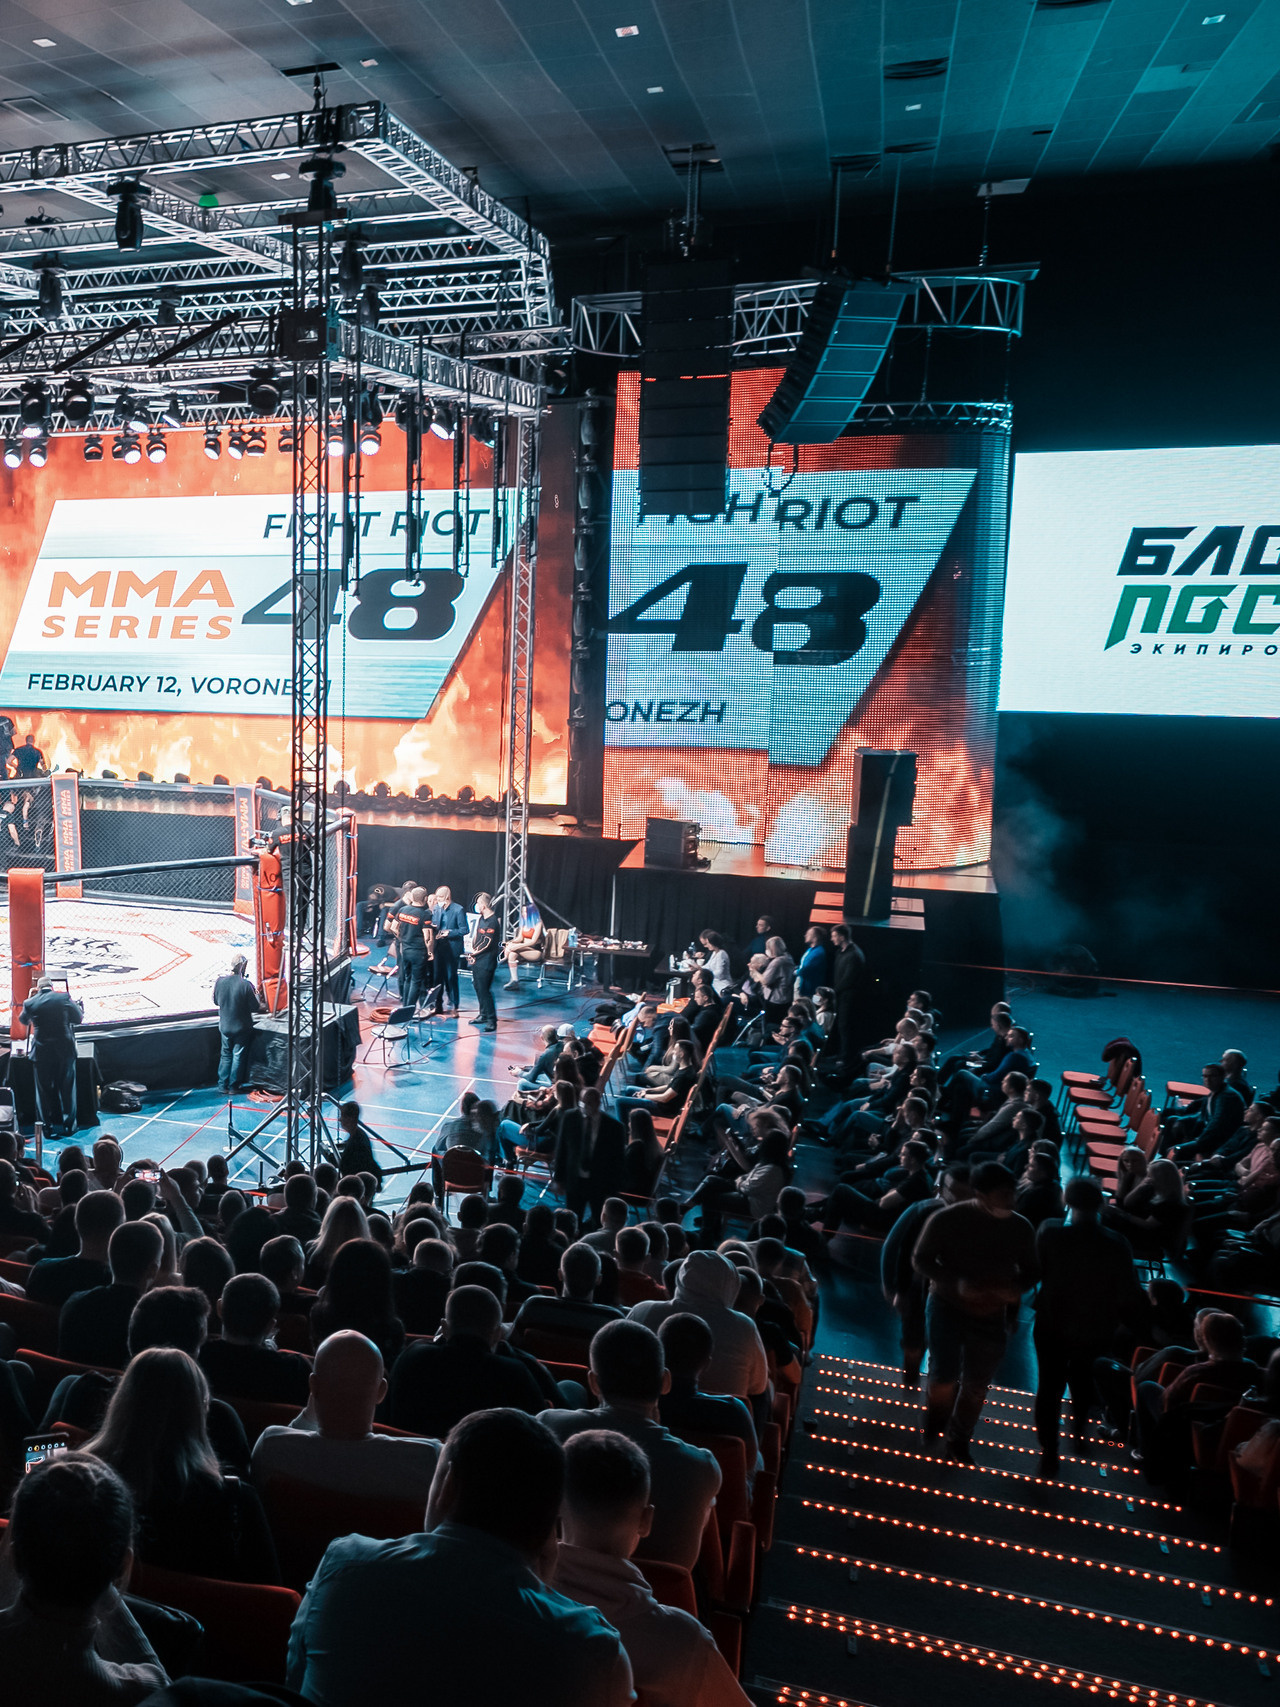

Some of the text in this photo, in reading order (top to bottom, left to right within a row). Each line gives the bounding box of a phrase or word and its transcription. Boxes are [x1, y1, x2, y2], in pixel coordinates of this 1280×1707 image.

[775, 496, 921, 531] RIOT
[48, 568, 465, 641] MMA 48
[608, 562, 881, 666] 48
[42, 614, 234, 641] SERIES
[1130, 643, 1279, 656] ЭКИПИРО
[27, 673, 151, 694] FEBRUARY
[157, 676, 182, 697] 12,
[605, 700, 726, 724] ONEZH
